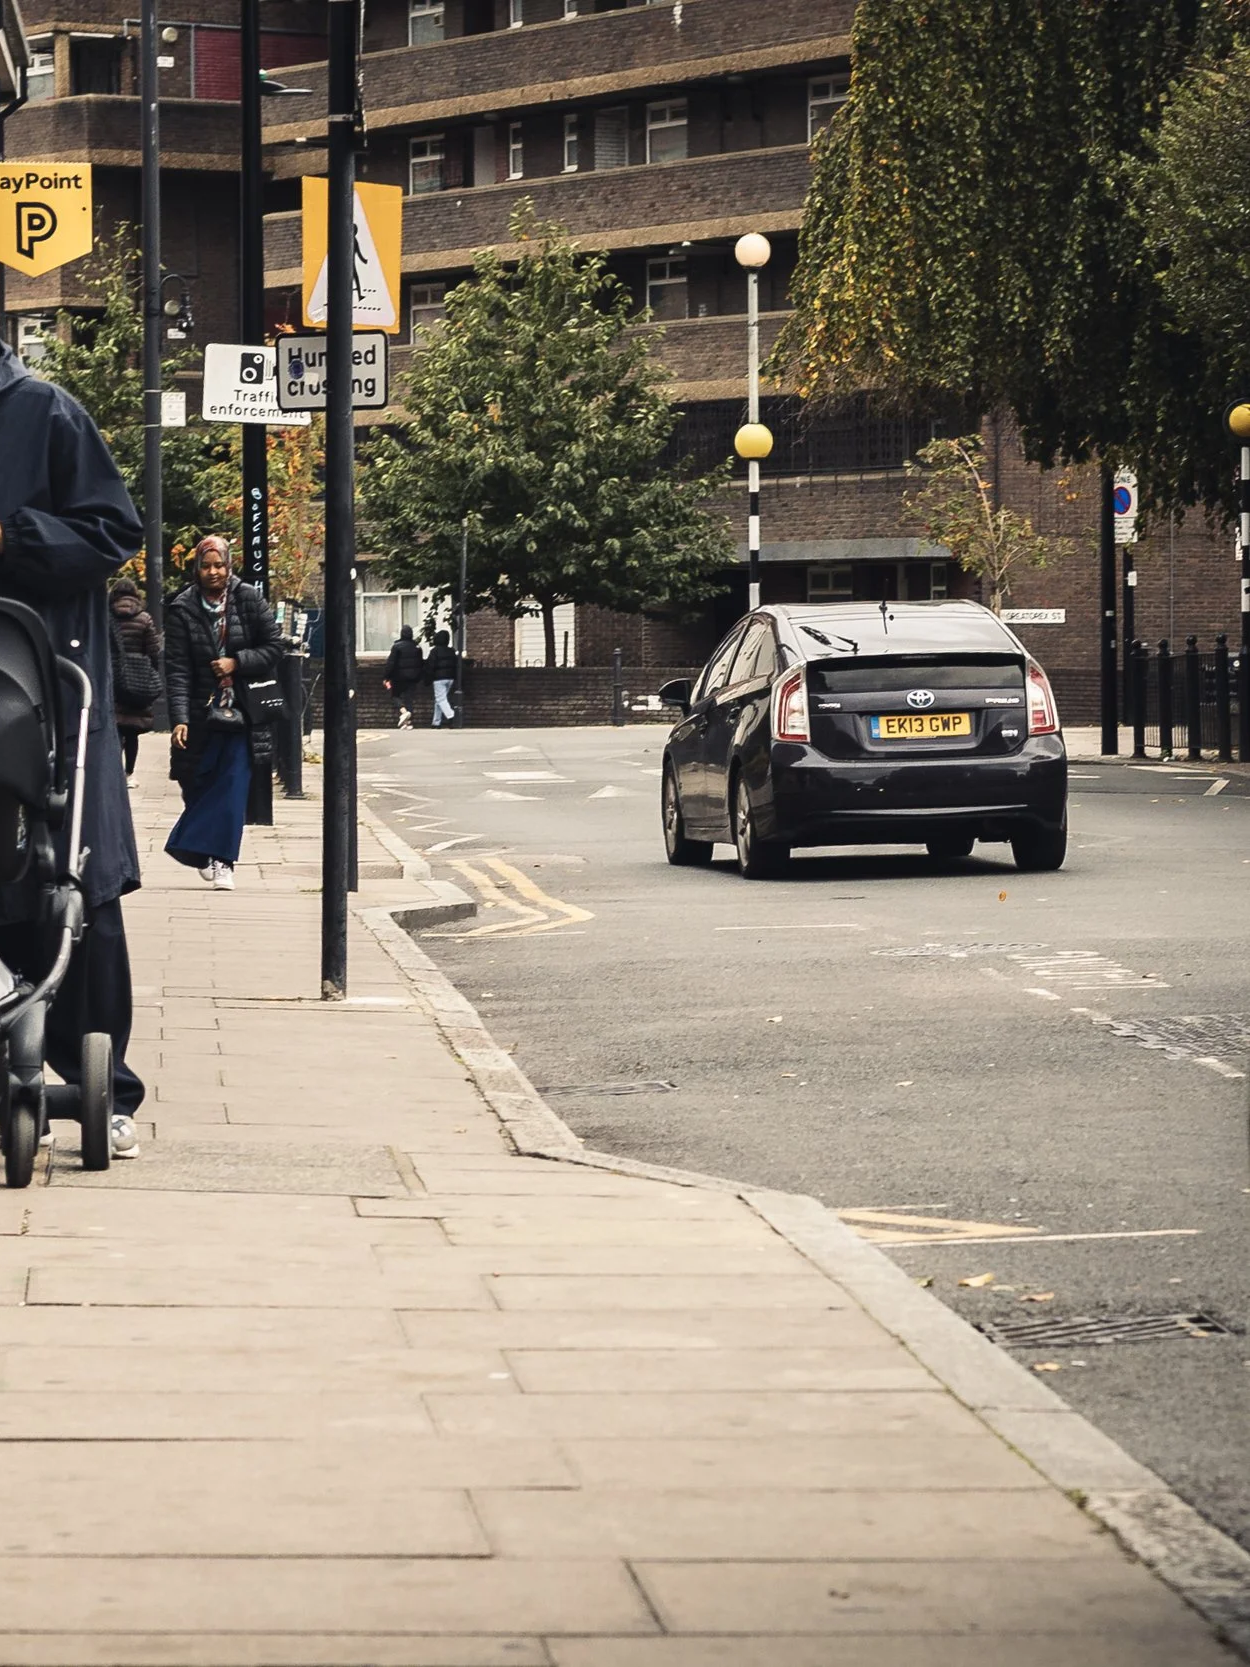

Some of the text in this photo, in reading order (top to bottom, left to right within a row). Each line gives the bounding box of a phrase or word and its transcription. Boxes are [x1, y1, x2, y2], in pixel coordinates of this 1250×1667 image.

[234, 389, 275, 403] Traffi
[886, 716, 962, 734] EK13 GWP
